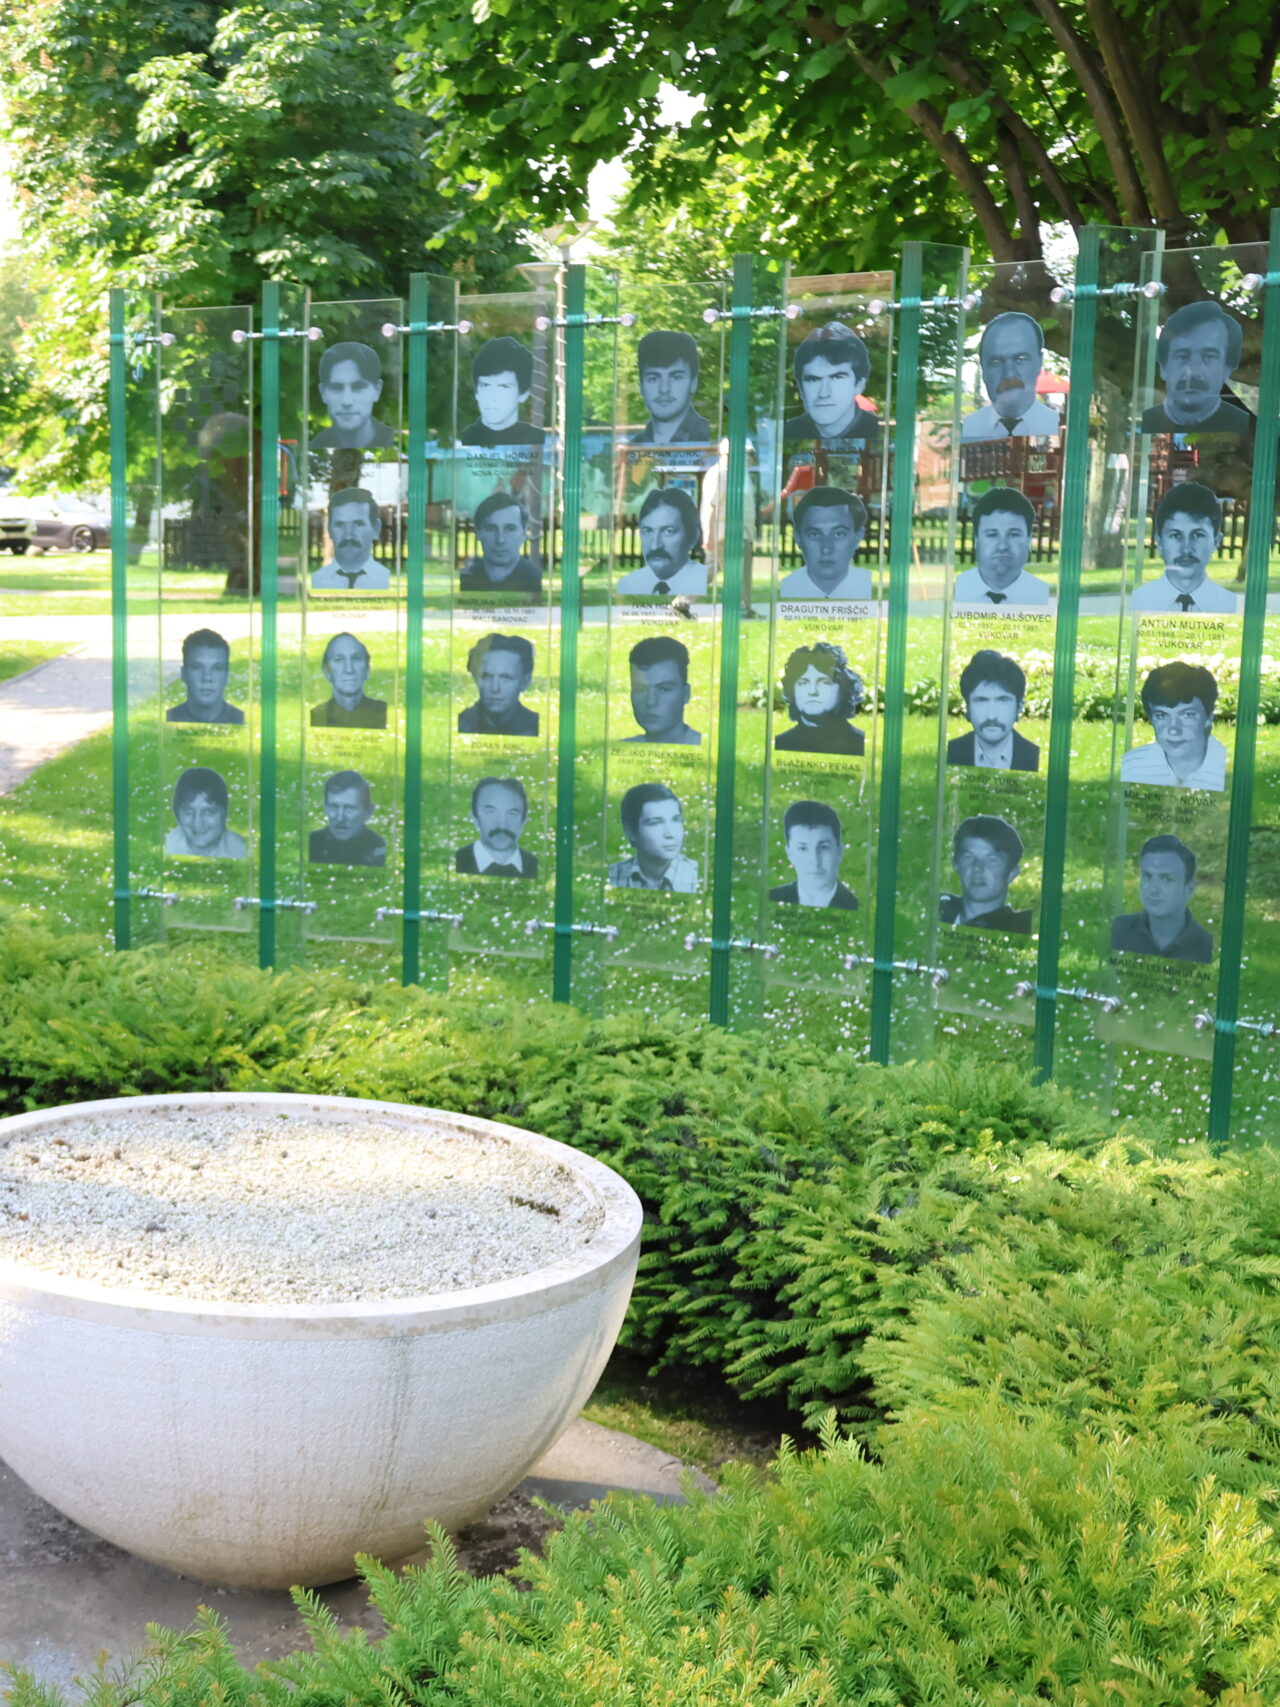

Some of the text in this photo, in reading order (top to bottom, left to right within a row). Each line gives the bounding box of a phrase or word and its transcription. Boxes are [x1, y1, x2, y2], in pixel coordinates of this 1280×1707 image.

[780, 604, 830, 614] DRAGUTIN
[948, 611, 1053, 623] LJUBOMIR JALŠOVEC
[803, 623, 844, 631] VUKOVAR
[1140, 618, 1225, 631] ANTUN MUTVAR
[978, 632, 1020, 640] VUKOVAR
[1158, 640, 1204, 650] VUKOVAR
[775, 758, 827, 769] BLAŽENKO
[1179, 795, 1218, 809] NOVAK
